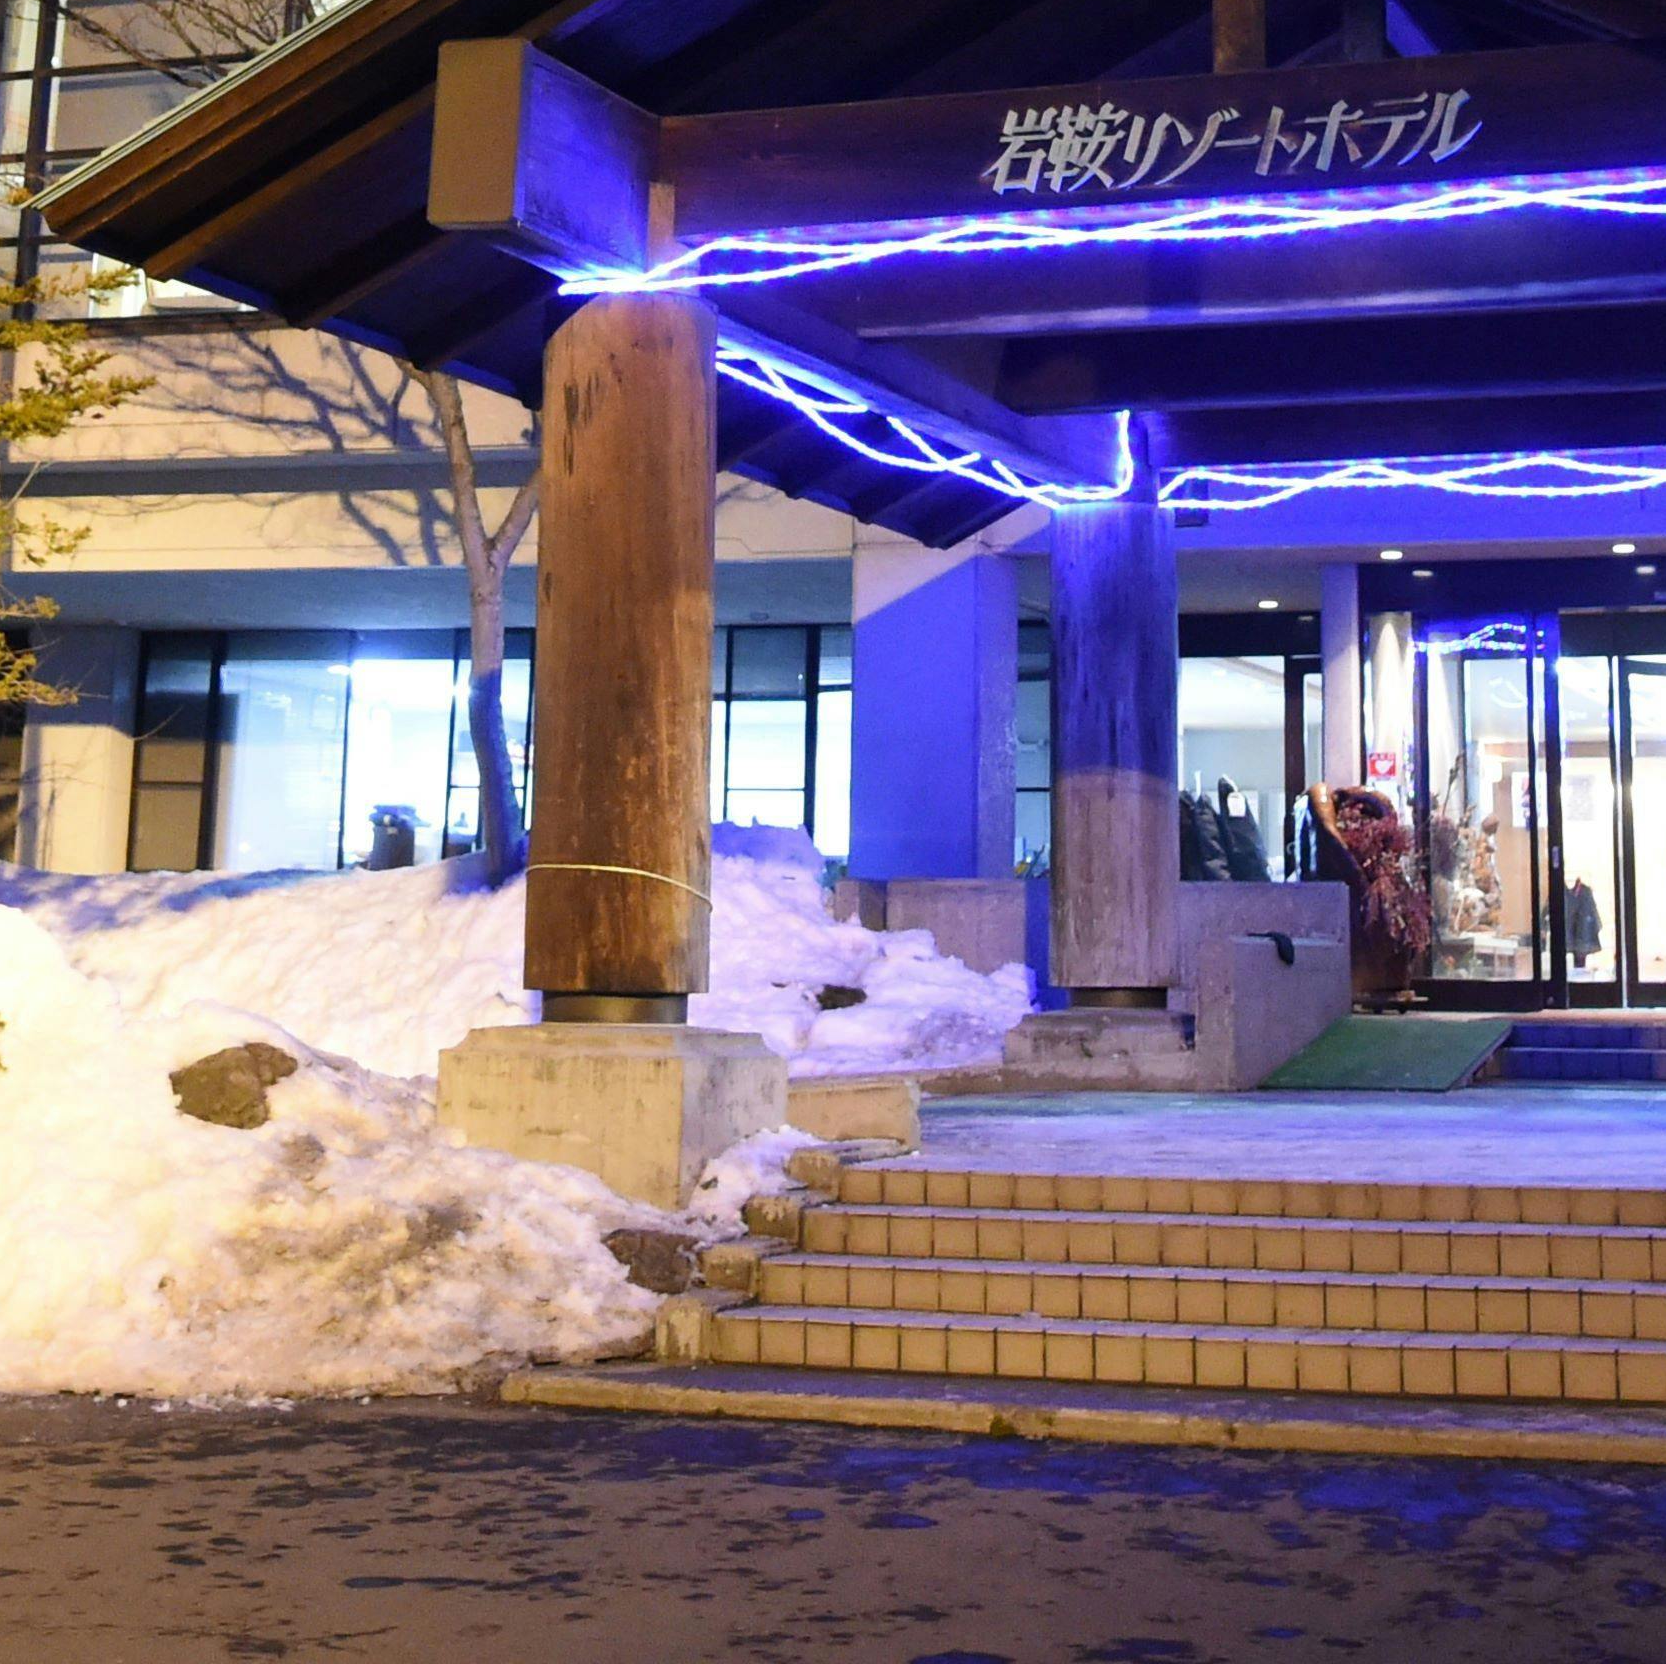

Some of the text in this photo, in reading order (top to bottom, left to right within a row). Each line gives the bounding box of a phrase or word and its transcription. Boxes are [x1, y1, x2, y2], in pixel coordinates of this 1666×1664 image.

[981, 88, 1482, 195] 岩鞍リゾートホテル
